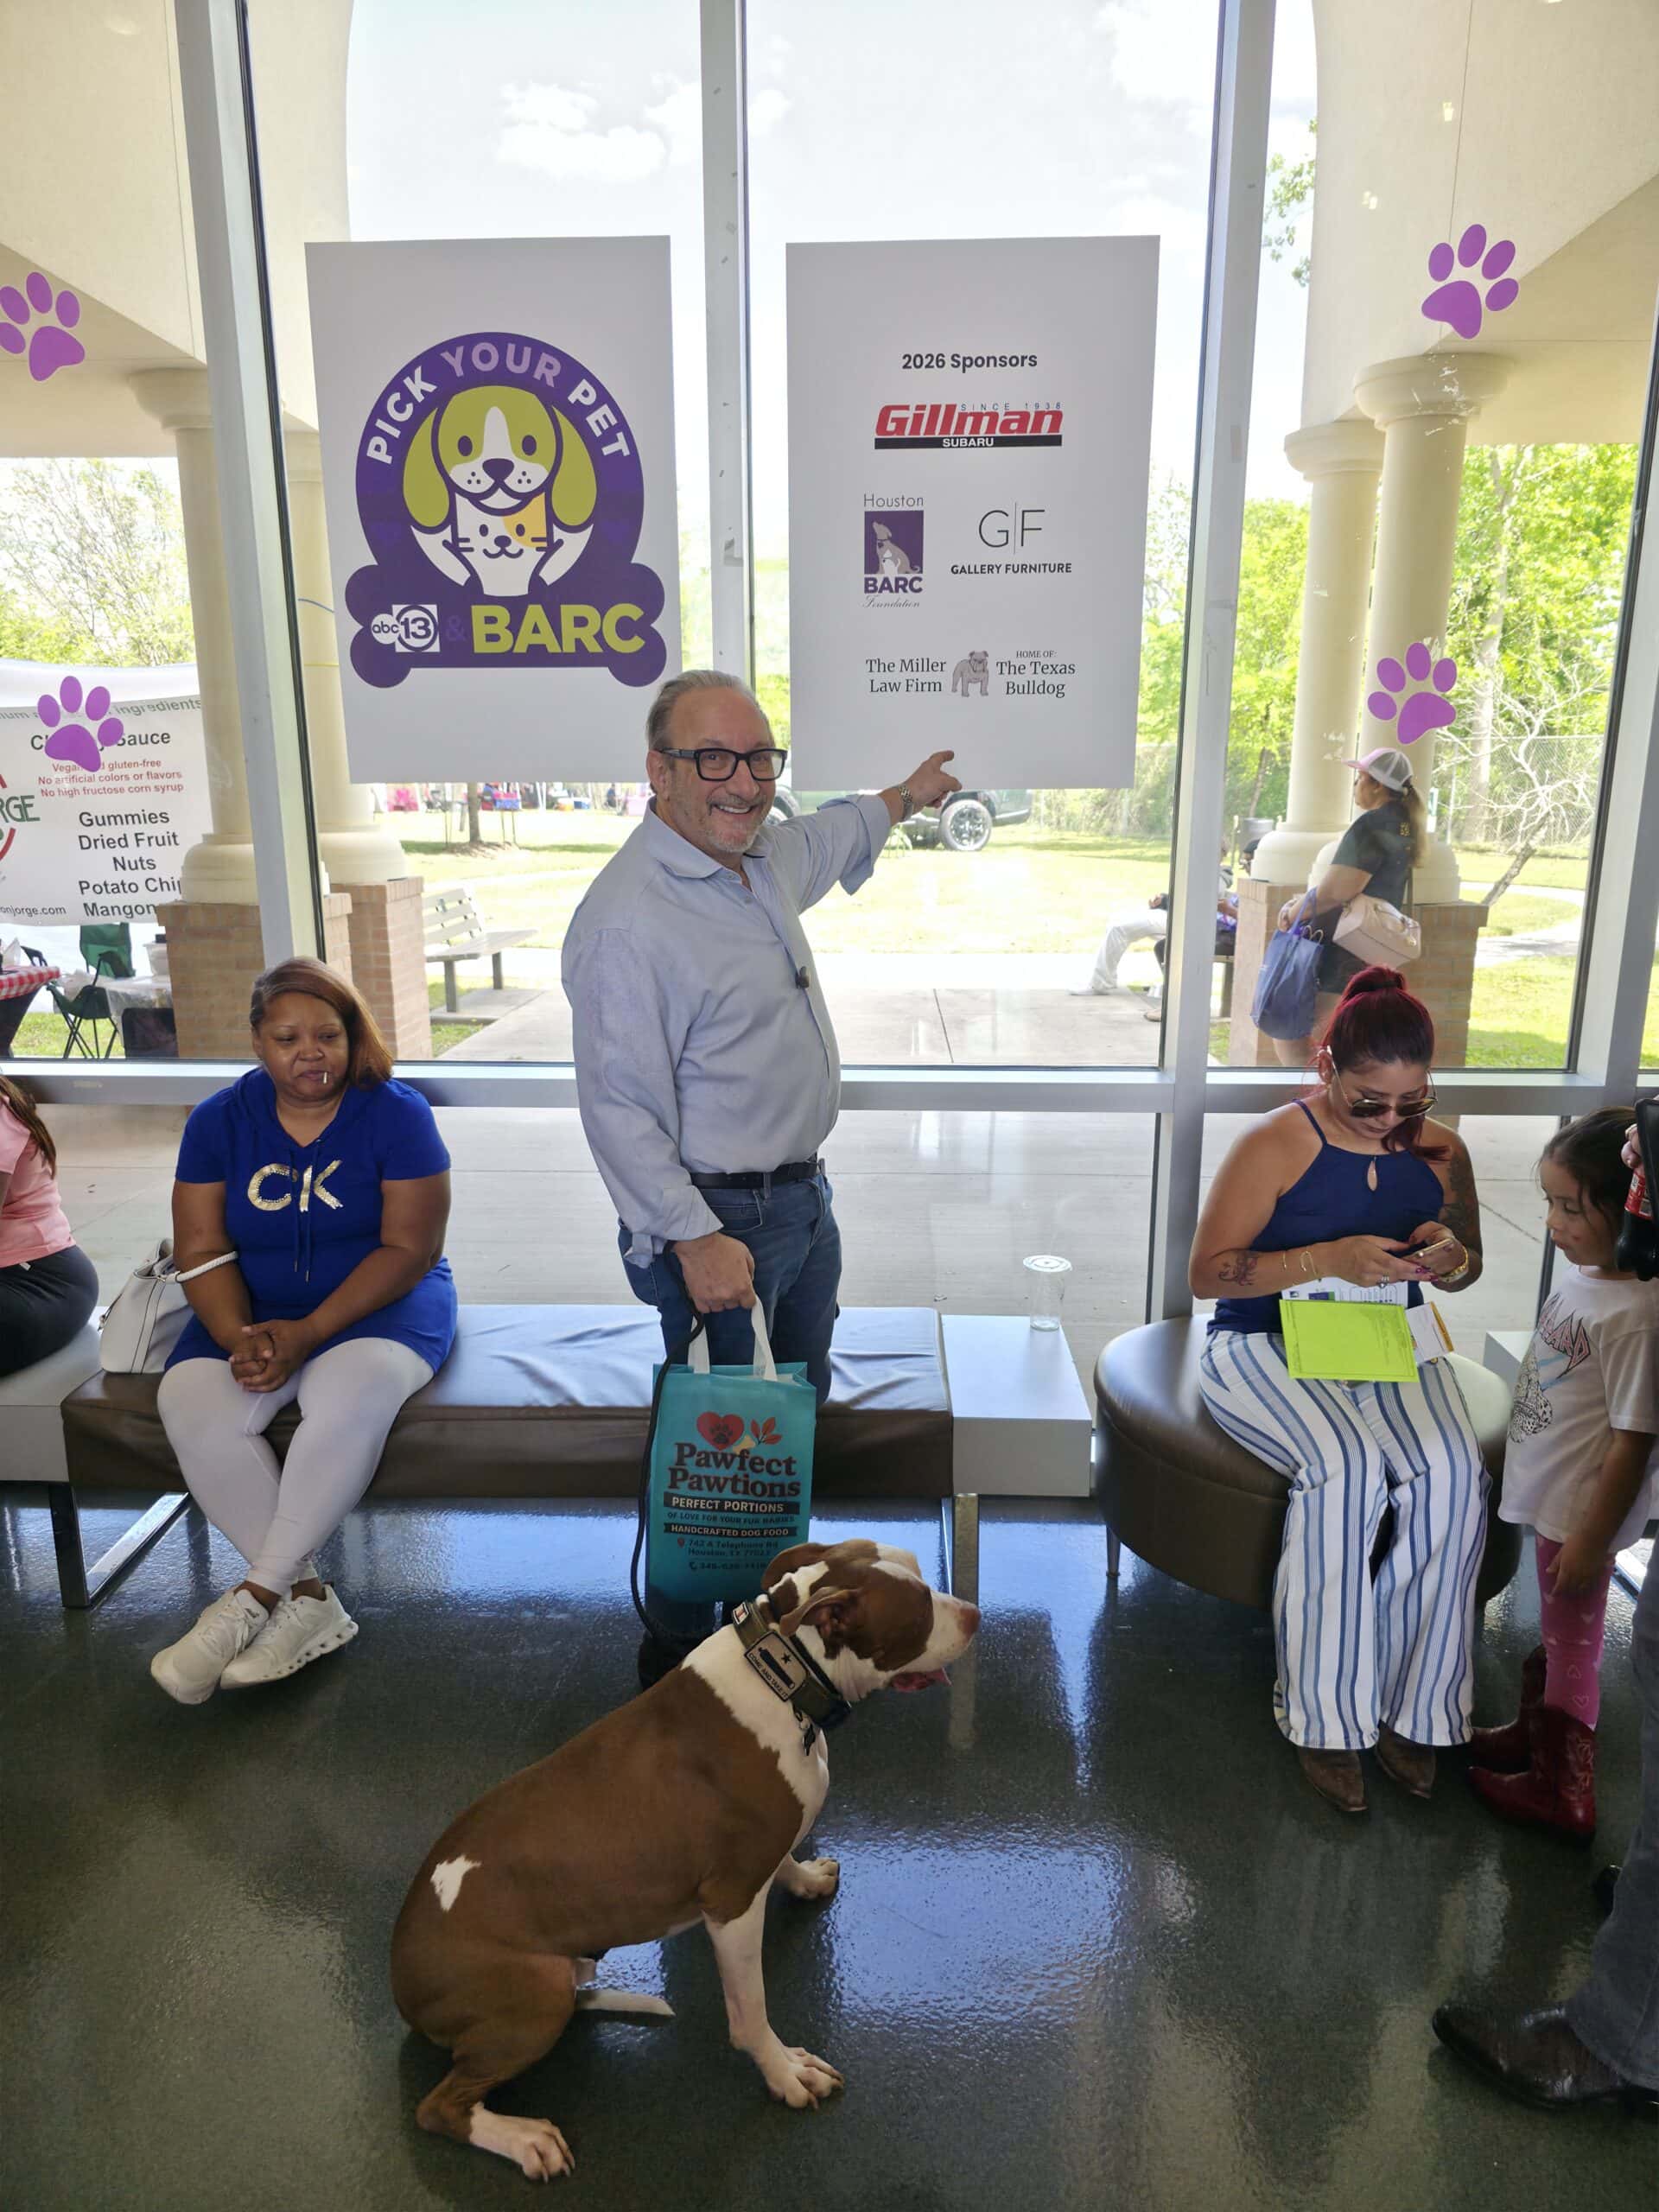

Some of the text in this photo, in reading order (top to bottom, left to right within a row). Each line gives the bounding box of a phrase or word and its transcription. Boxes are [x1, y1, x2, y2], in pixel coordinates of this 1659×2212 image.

[901, 353, 1038, 373] 2026 Sponsors
[366, 342, 631, 465] PICK YOUR PET
[961, 403, 1010, 411] SINCE
[875, 404, 1064, 435] Gillman
[943, 437, 994, 448] SUBARU
[864, 493, 924, 507] Houston
[950, 563, 1072, 575] GALLERY FURNITURE
[864, 576, 924, 594] BARC
[863, 594, 920, 608] Foundation
[372, 620, 399, 634] abc
[400, 617, 431, 639] 13
[471, 603, 645, 653] BARC
[865, 658, 947, 673] The Miller
[996, 660, 1076, 676] The Texas
[869, 678, 943, 693] Law Firm
[1005, 680, 1067, 698] Bulldog
[108, 760, 162, 772] gluten-free
[54, 774, 96, 785] artificial
[99, 772, 130, 782] colors
[146, 771, 181, 779] flavors
[41, 783, 184, 798] No high fructose corn syrup
[79, 809, 170, 827] Gummies
[78, 831, 180, 850] Dried Fruit
[112, 855, 156, 872] Nuts
[79, 880, 139, 895] Potato
[247, 1160, 344, 1212] CK
[674, 1442, 797, 1476] Pawfect
[667, 1467, 801, 1497] Pawtions
[672, 1497, 784, 1512] PERFECT PORTIONS
[680, 1513, 700, 1522] LOVE
[671, 1524, 740, 1536] HANDCRAFTED
